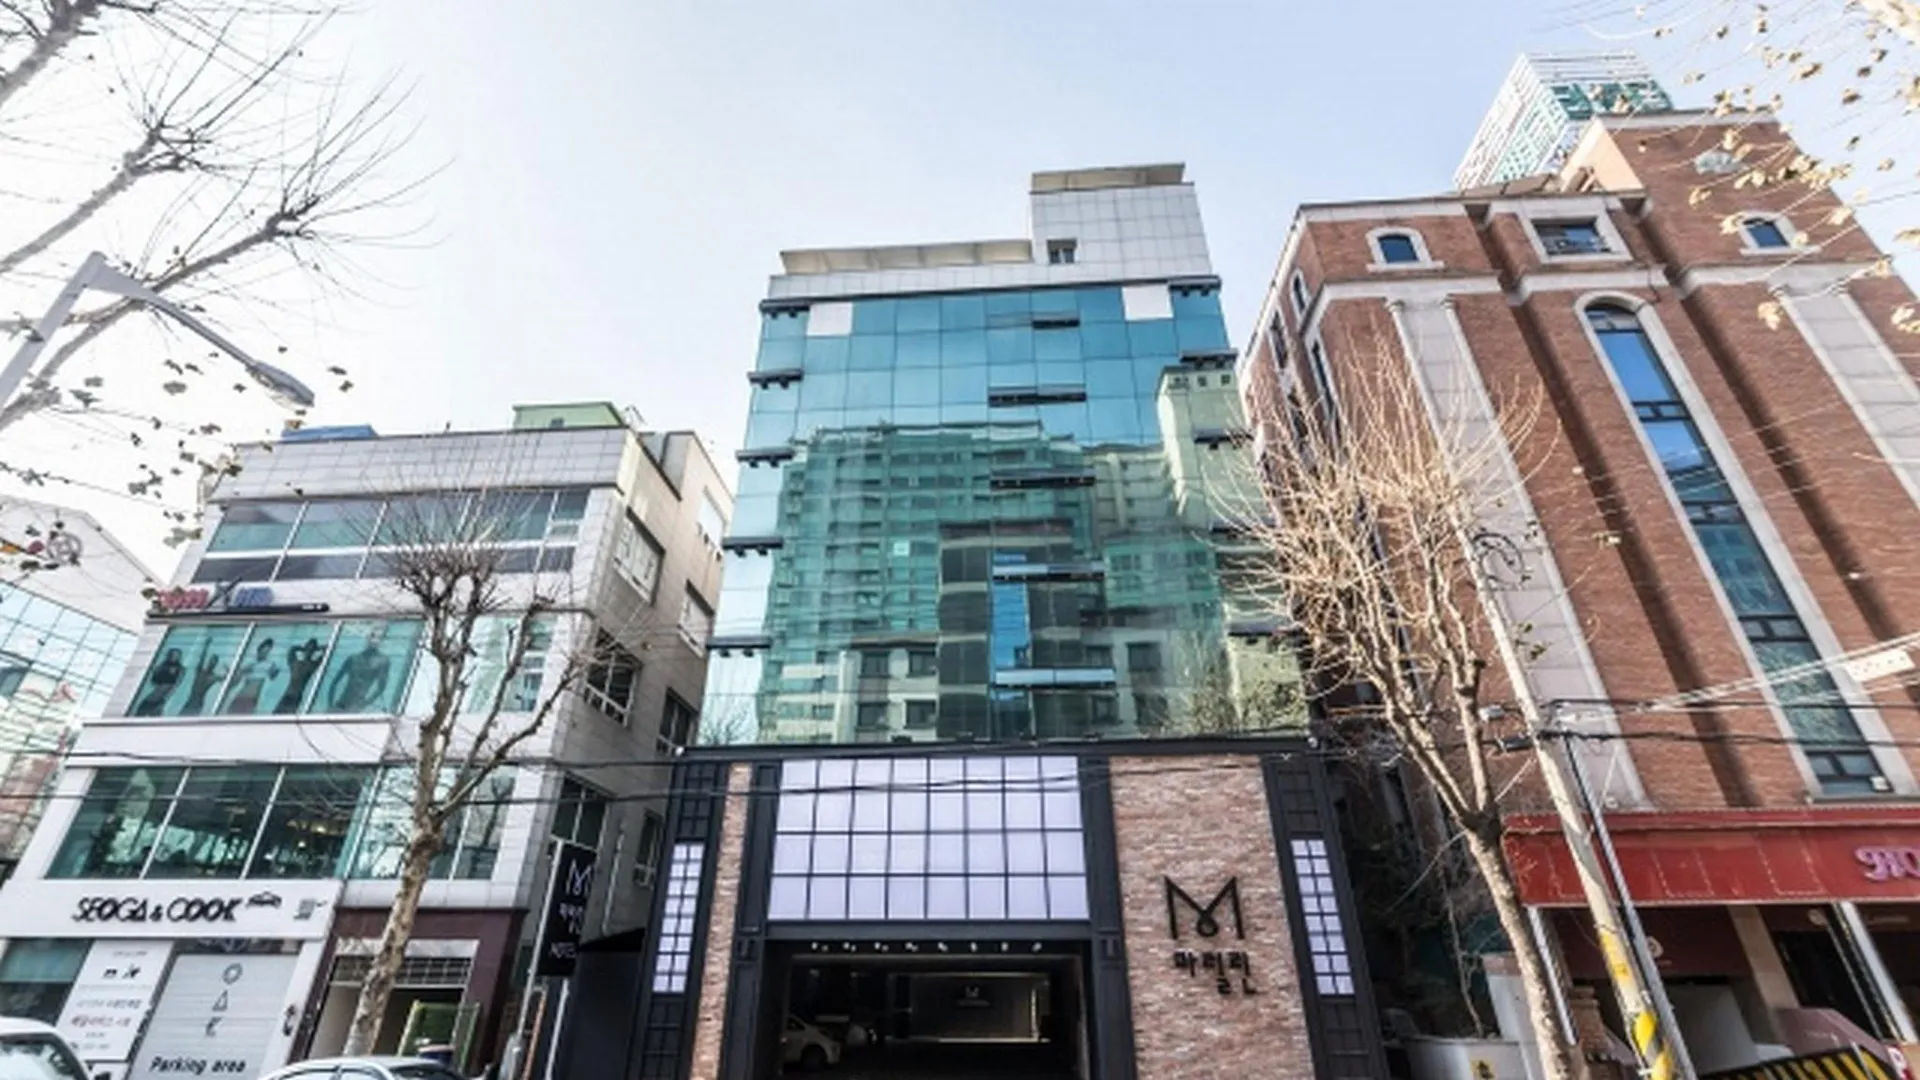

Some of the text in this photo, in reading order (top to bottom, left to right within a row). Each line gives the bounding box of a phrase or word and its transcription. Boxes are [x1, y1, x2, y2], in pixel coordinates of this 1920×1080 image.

[72, 897, 147, 922] SEOGA
[166, 897, 243, 922] COOK
[1164, 876, 1245, 939] M
[1173, 951, 1259, 995] 마릴린
[148, 1056, 246, 1076] Parking area
